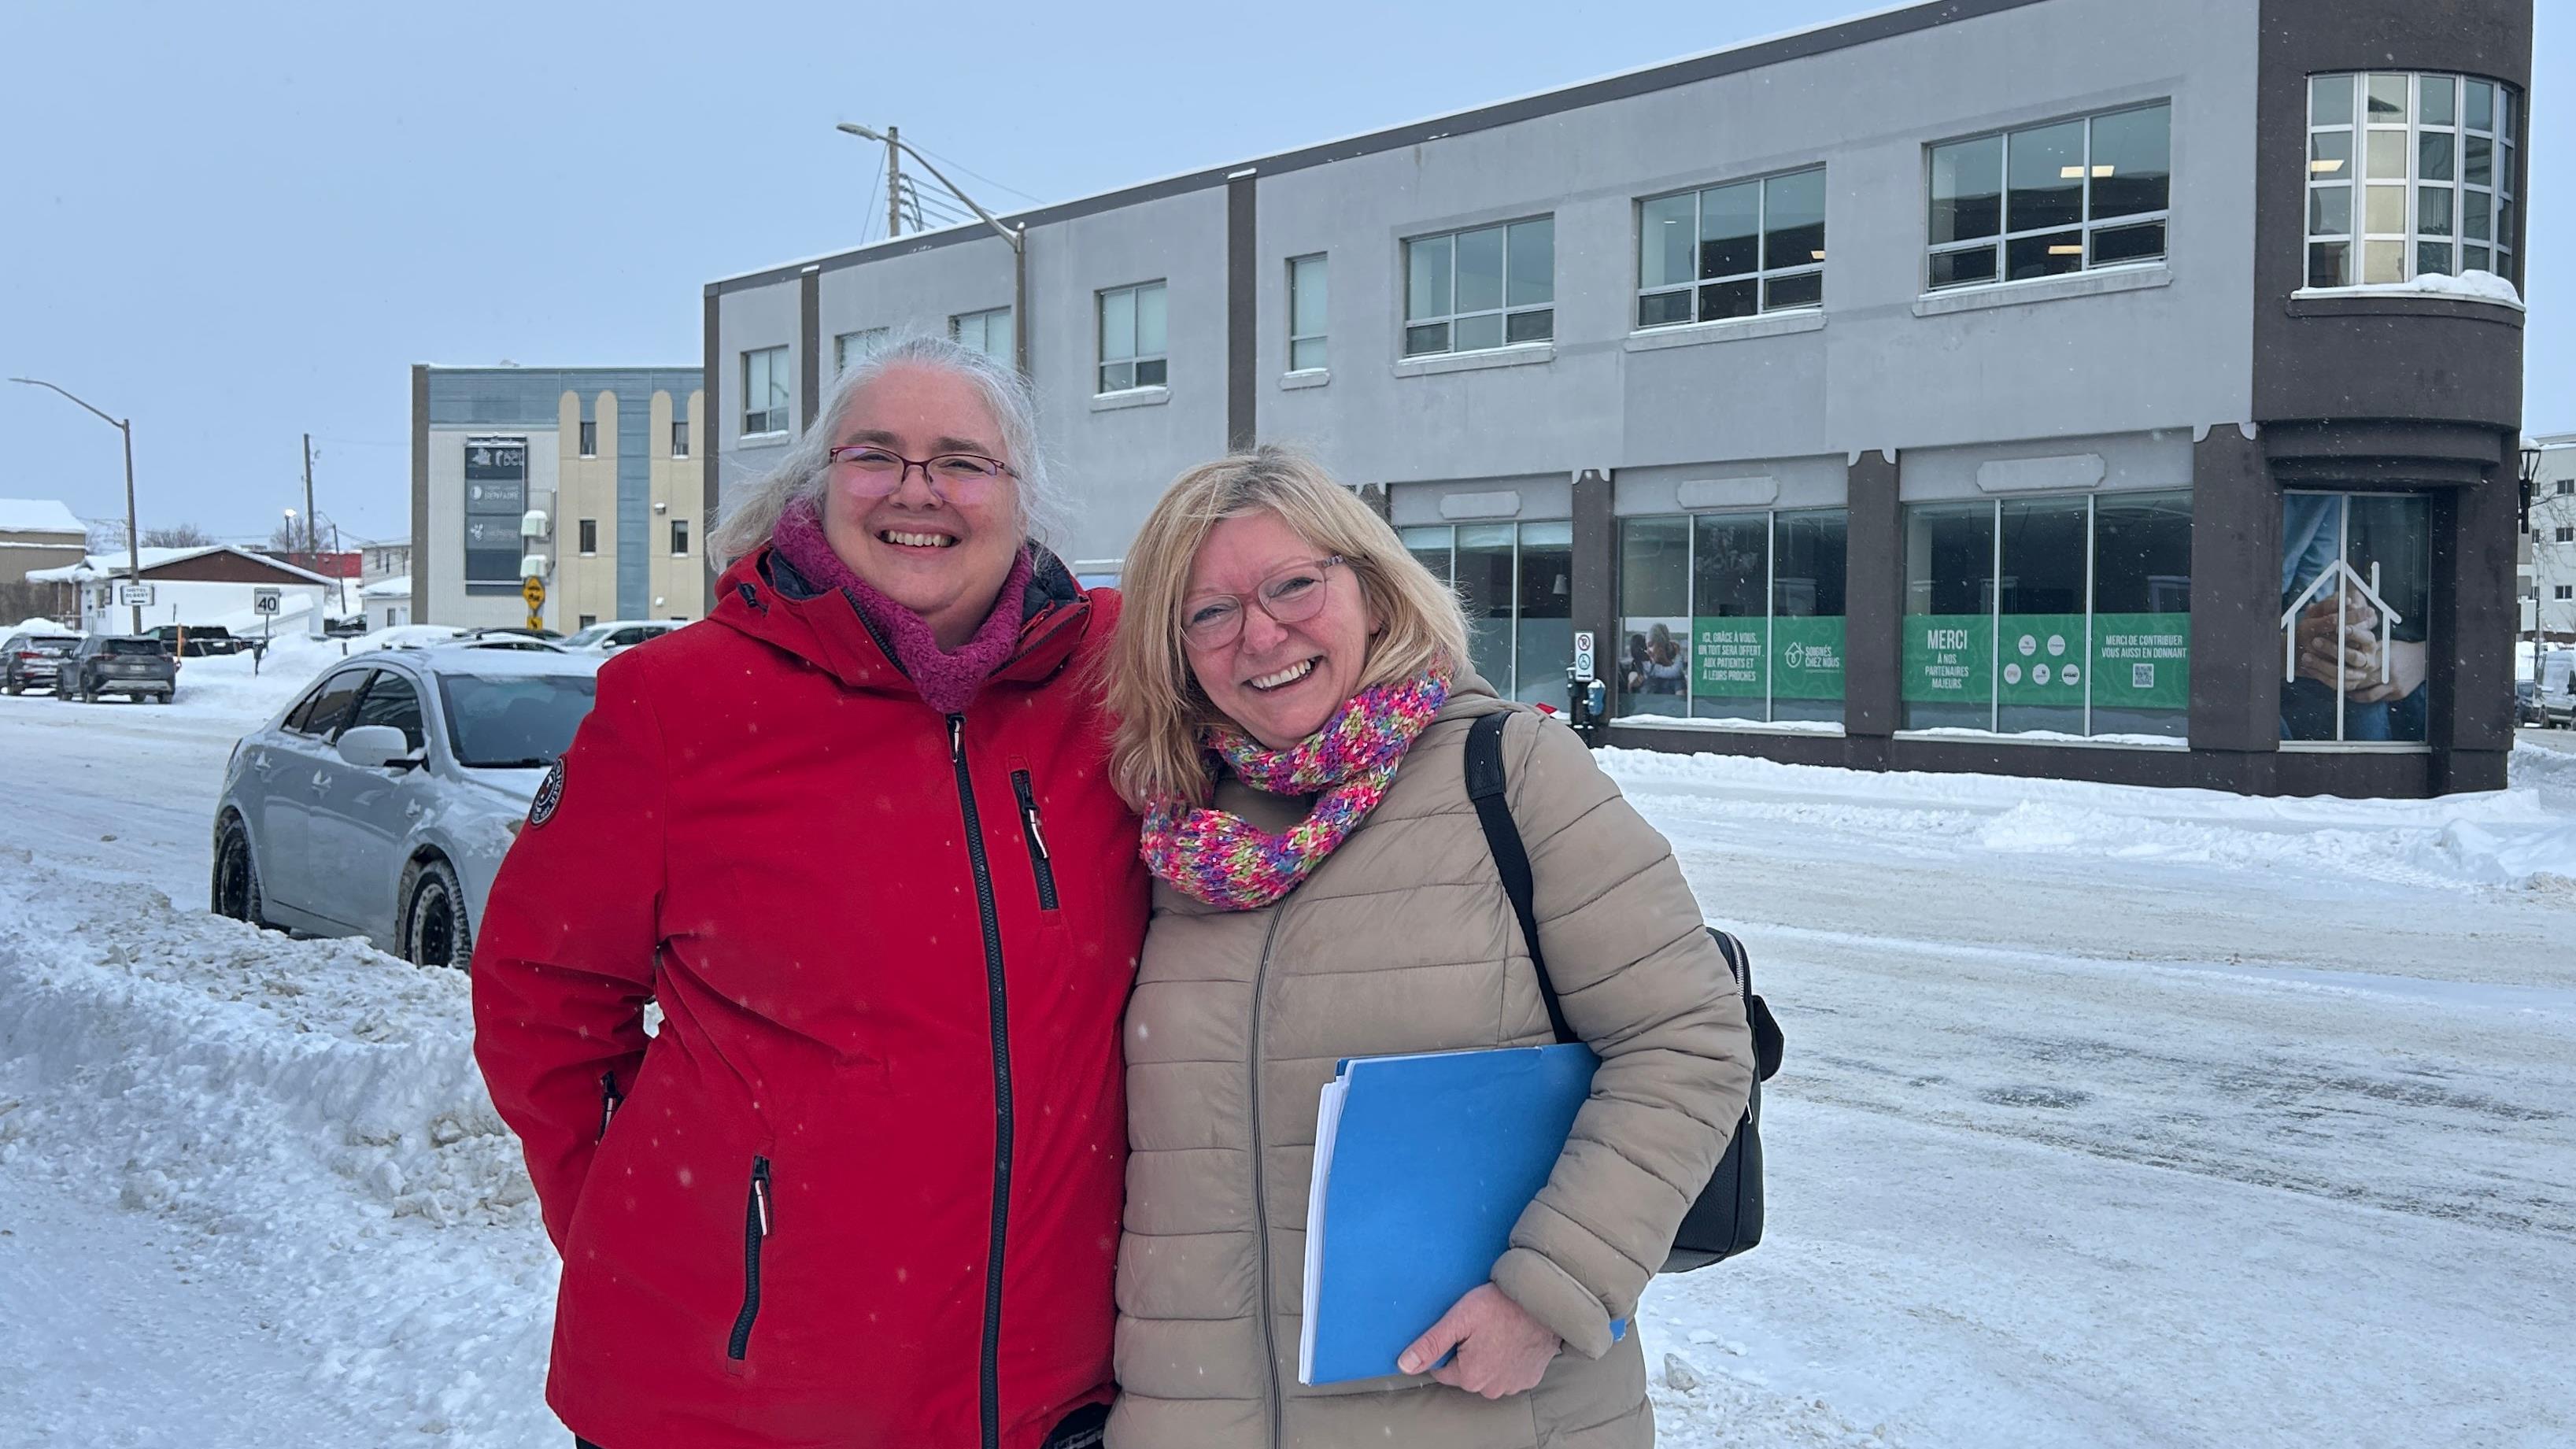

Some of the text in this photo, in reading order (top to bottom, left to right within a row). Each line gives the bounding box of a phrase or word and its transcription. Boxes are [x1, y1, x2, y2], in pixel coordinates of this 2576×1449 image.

[257, 597, 277, 612] 40
[1713, 630, 1732, 643] GRÂCE
[1927, 629, 1968, 650] MERCI
[2105, 634, 2182, 646] MERCI DE CONTRIBUER
[1722, 645, 1738, 656] SERA
[1739, 645, 1761, 656] OFFERT
[1805, 644, 1831, 657] SOIGNÉS
[2101, 647, 2187, 658] VOUS AUSSI EN DONNANT
[1704, 656, 1754, 668] AUX PATIENTS ET
[1805, 656, 1840, 667] CHEZ NOUS
[1943, 653, 1957, 664] NOS
[1728, 670, 1756, 682] PROCHES
[1925, 665, 1969, 678] PARTENAIRES
[1932, 678, 1962, 689] MAJEURS
